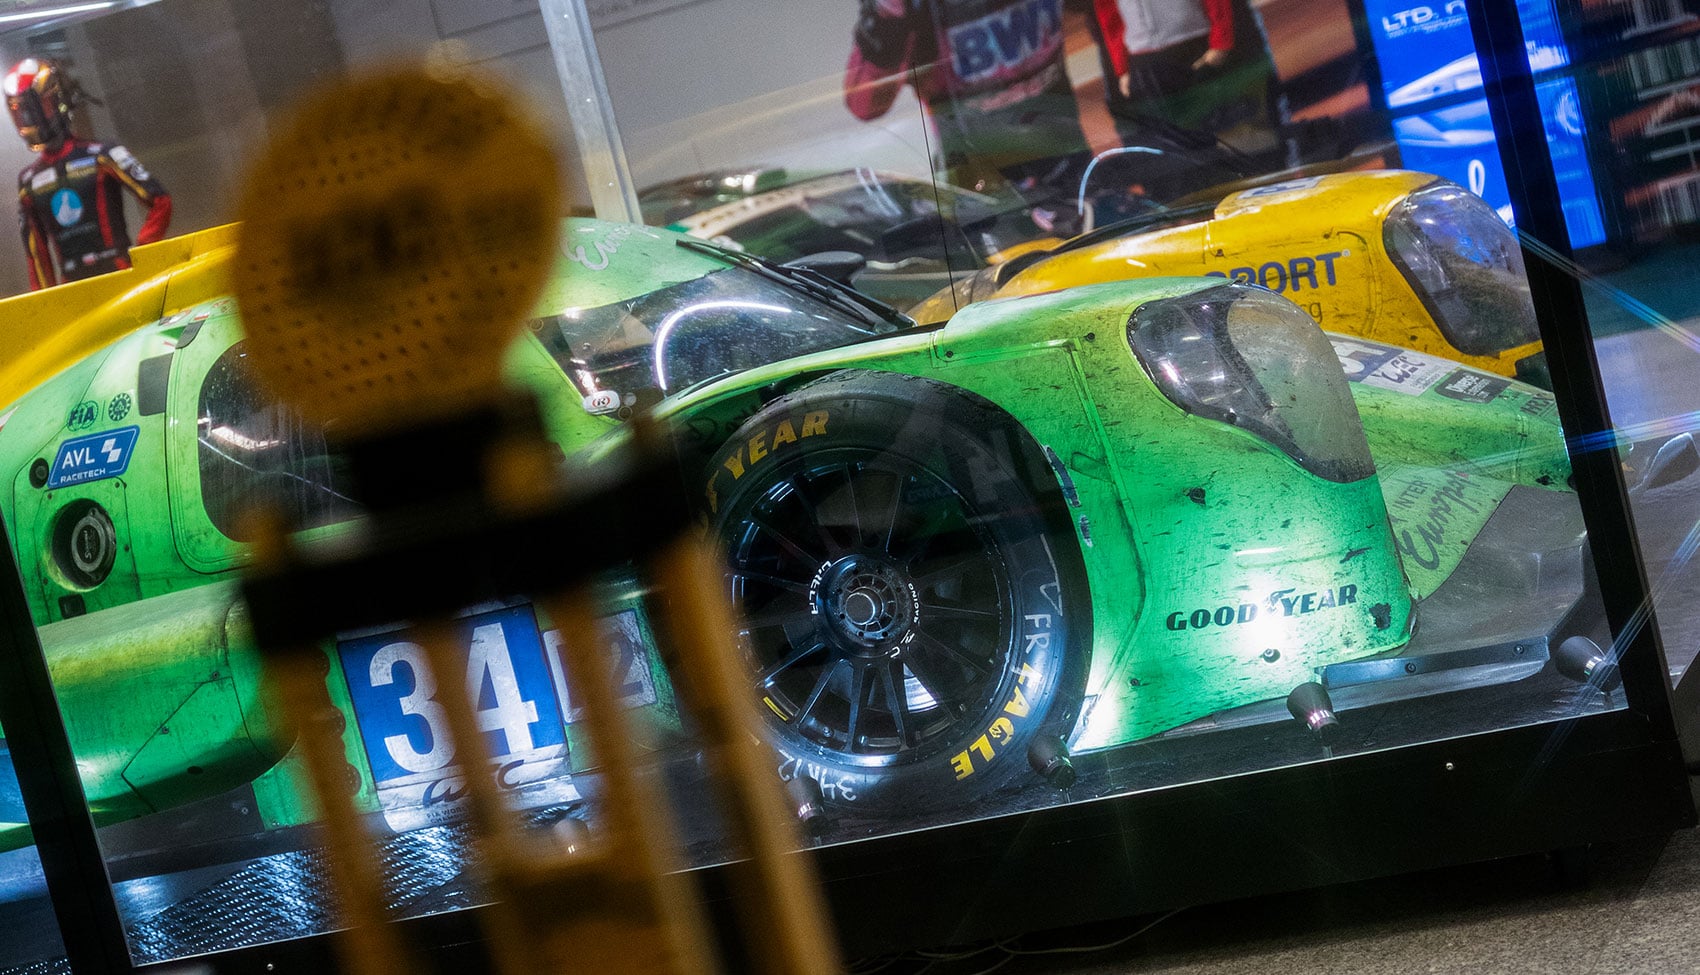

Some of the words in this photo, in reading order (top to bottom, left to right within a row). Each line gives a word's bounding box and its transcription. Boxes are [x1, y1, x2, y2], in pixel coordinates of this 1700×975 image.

[1204, 251, 1342, 295] PORT
[68, 403, 96, 428] FIA
[60, 467, 106, 484] RACETECH
[61, 446, 96, 470] AVL
[1392, 480, 1431, 509] INTER
[1022, 612, 1051, 655] FR
[368, 622, 540, 774] 34
[950, 662, 1042, 782] EAGLE
